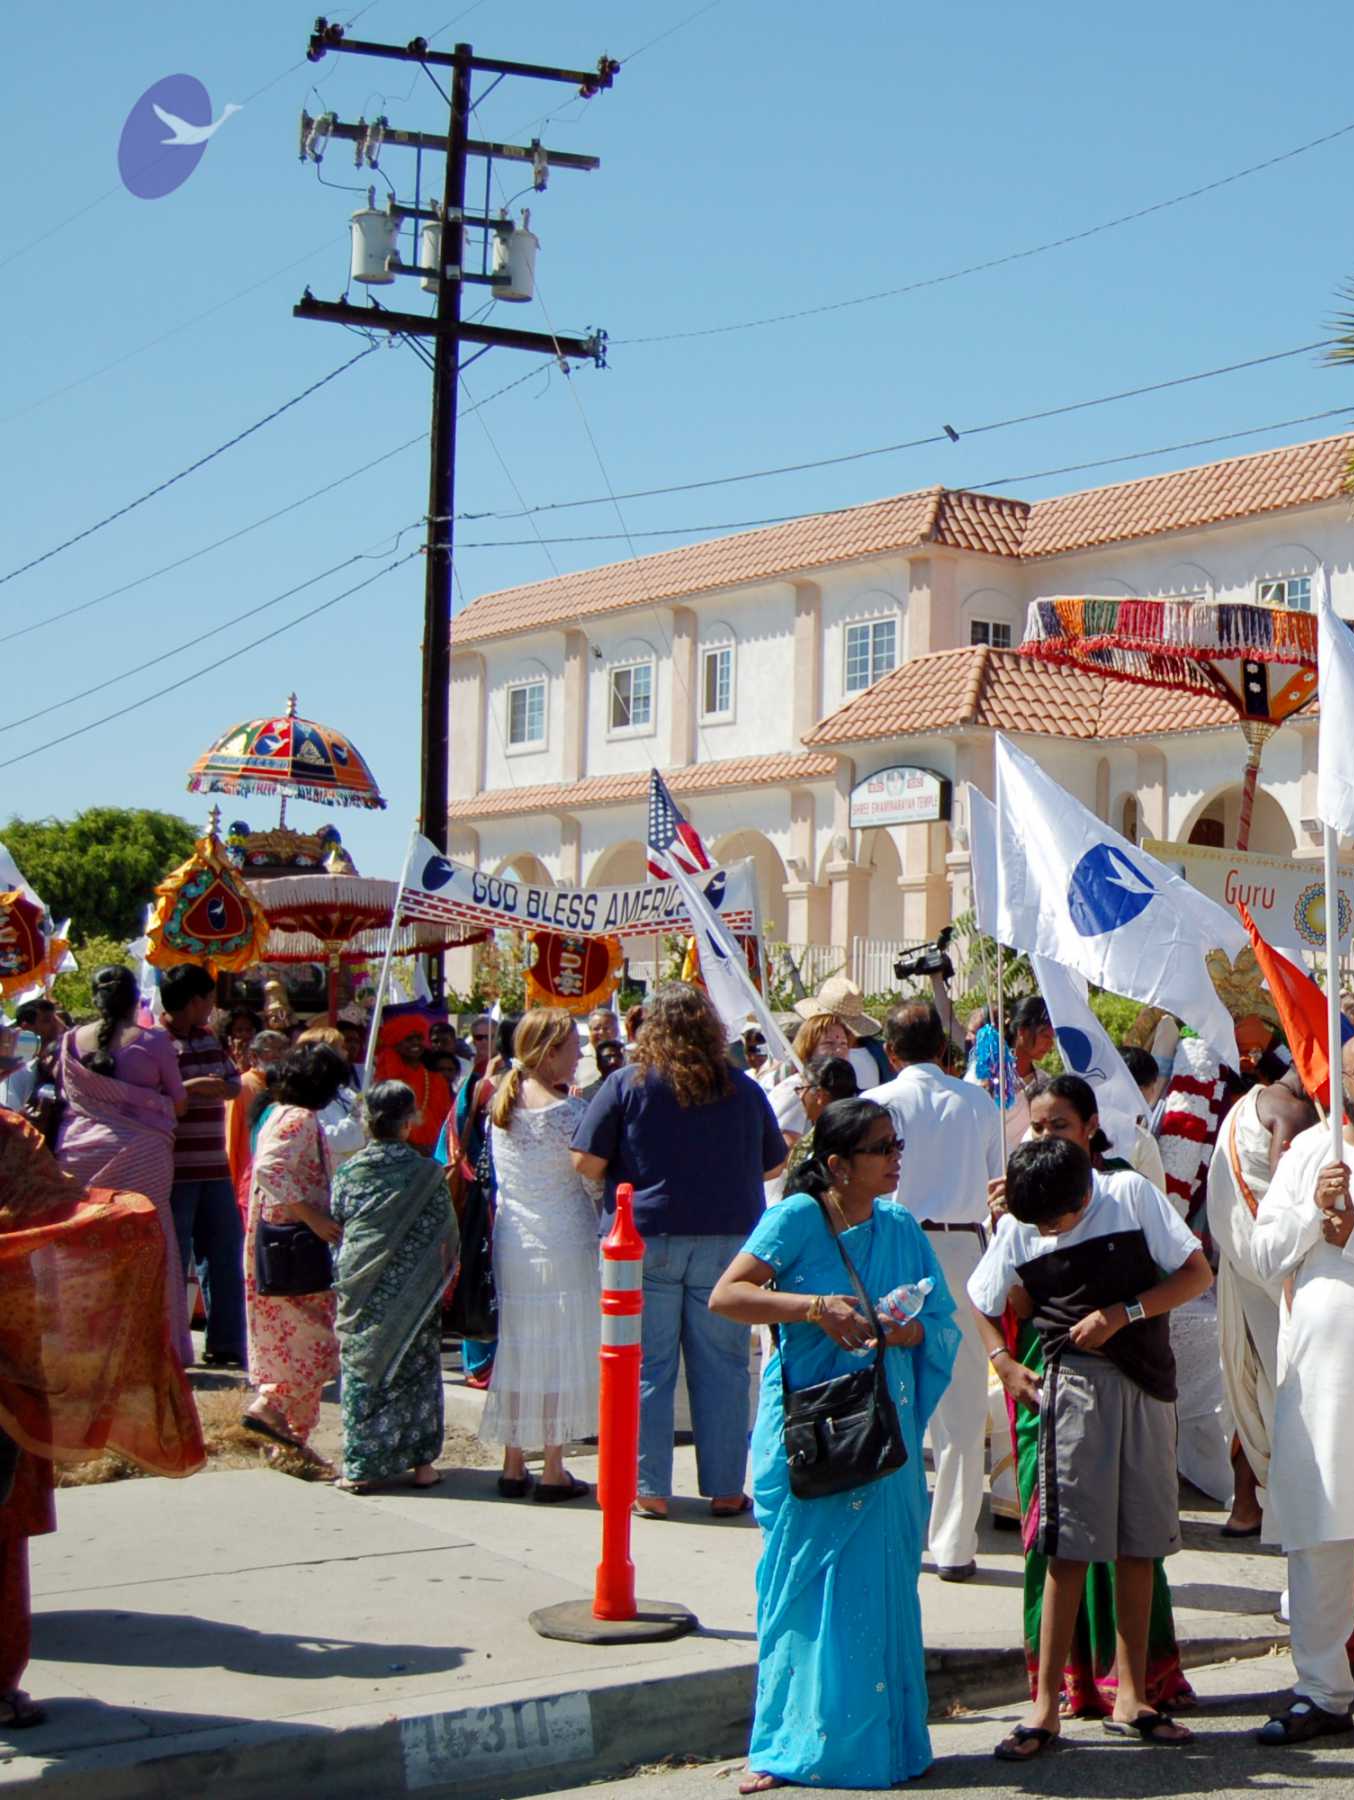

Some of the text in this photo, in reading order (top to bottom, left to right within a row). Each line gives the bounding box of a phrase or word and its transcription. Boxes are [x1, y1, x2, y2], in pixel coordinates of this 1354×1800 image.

[472, 871, 519, 911] GOD
[527, 889, 597, 931] BLESS
[1224, 869, 1275, 909] Guru
